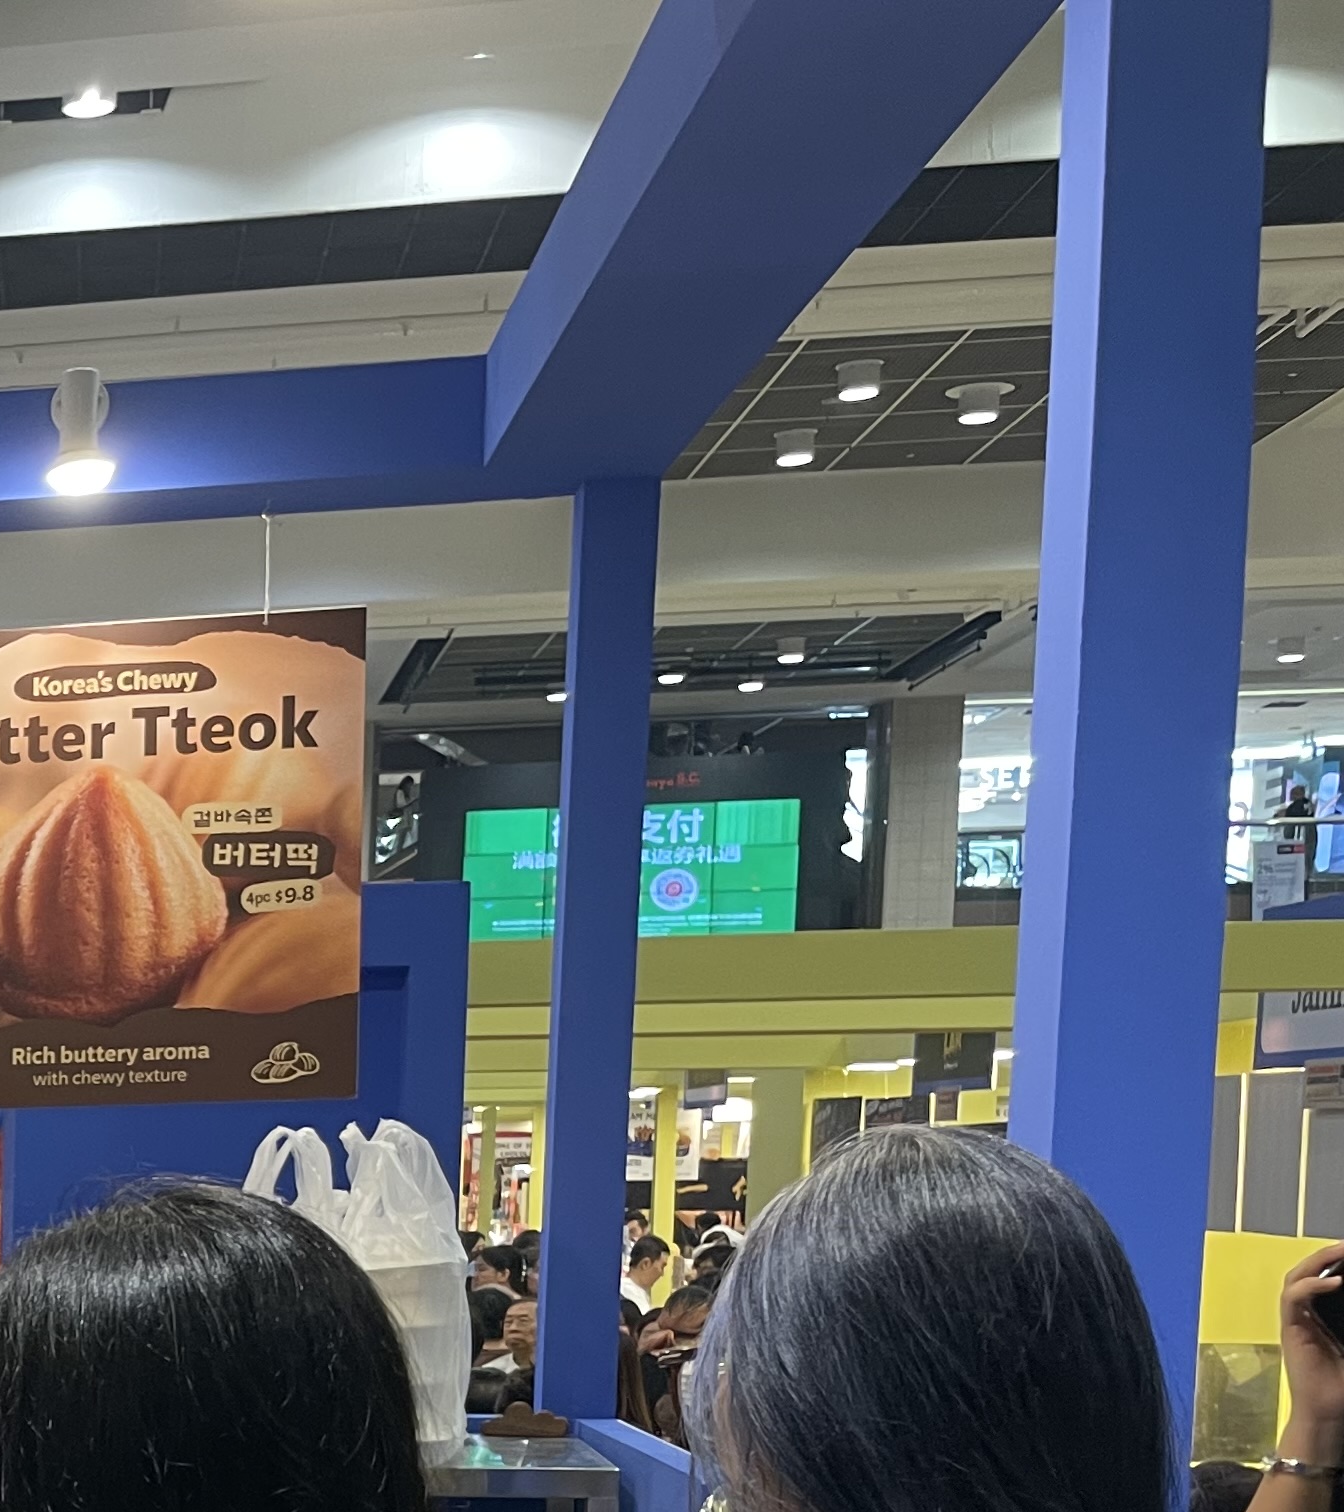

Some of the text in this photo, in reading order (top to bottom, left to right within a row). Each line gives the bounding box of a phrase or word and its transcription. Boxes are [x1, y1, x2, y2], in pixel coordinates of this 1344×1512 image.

[32, 668, 197, 696] Korea's Chewy
[132, 695, 320, 756] Tteok
[213, 841, 319, 874] 버터떡
[245, 885, 315, 907] 4pc $9.8
[12, 1044, 210, 1069] Rich buttery aroma
[32, 1068, 187, 1089] with chewy texture
